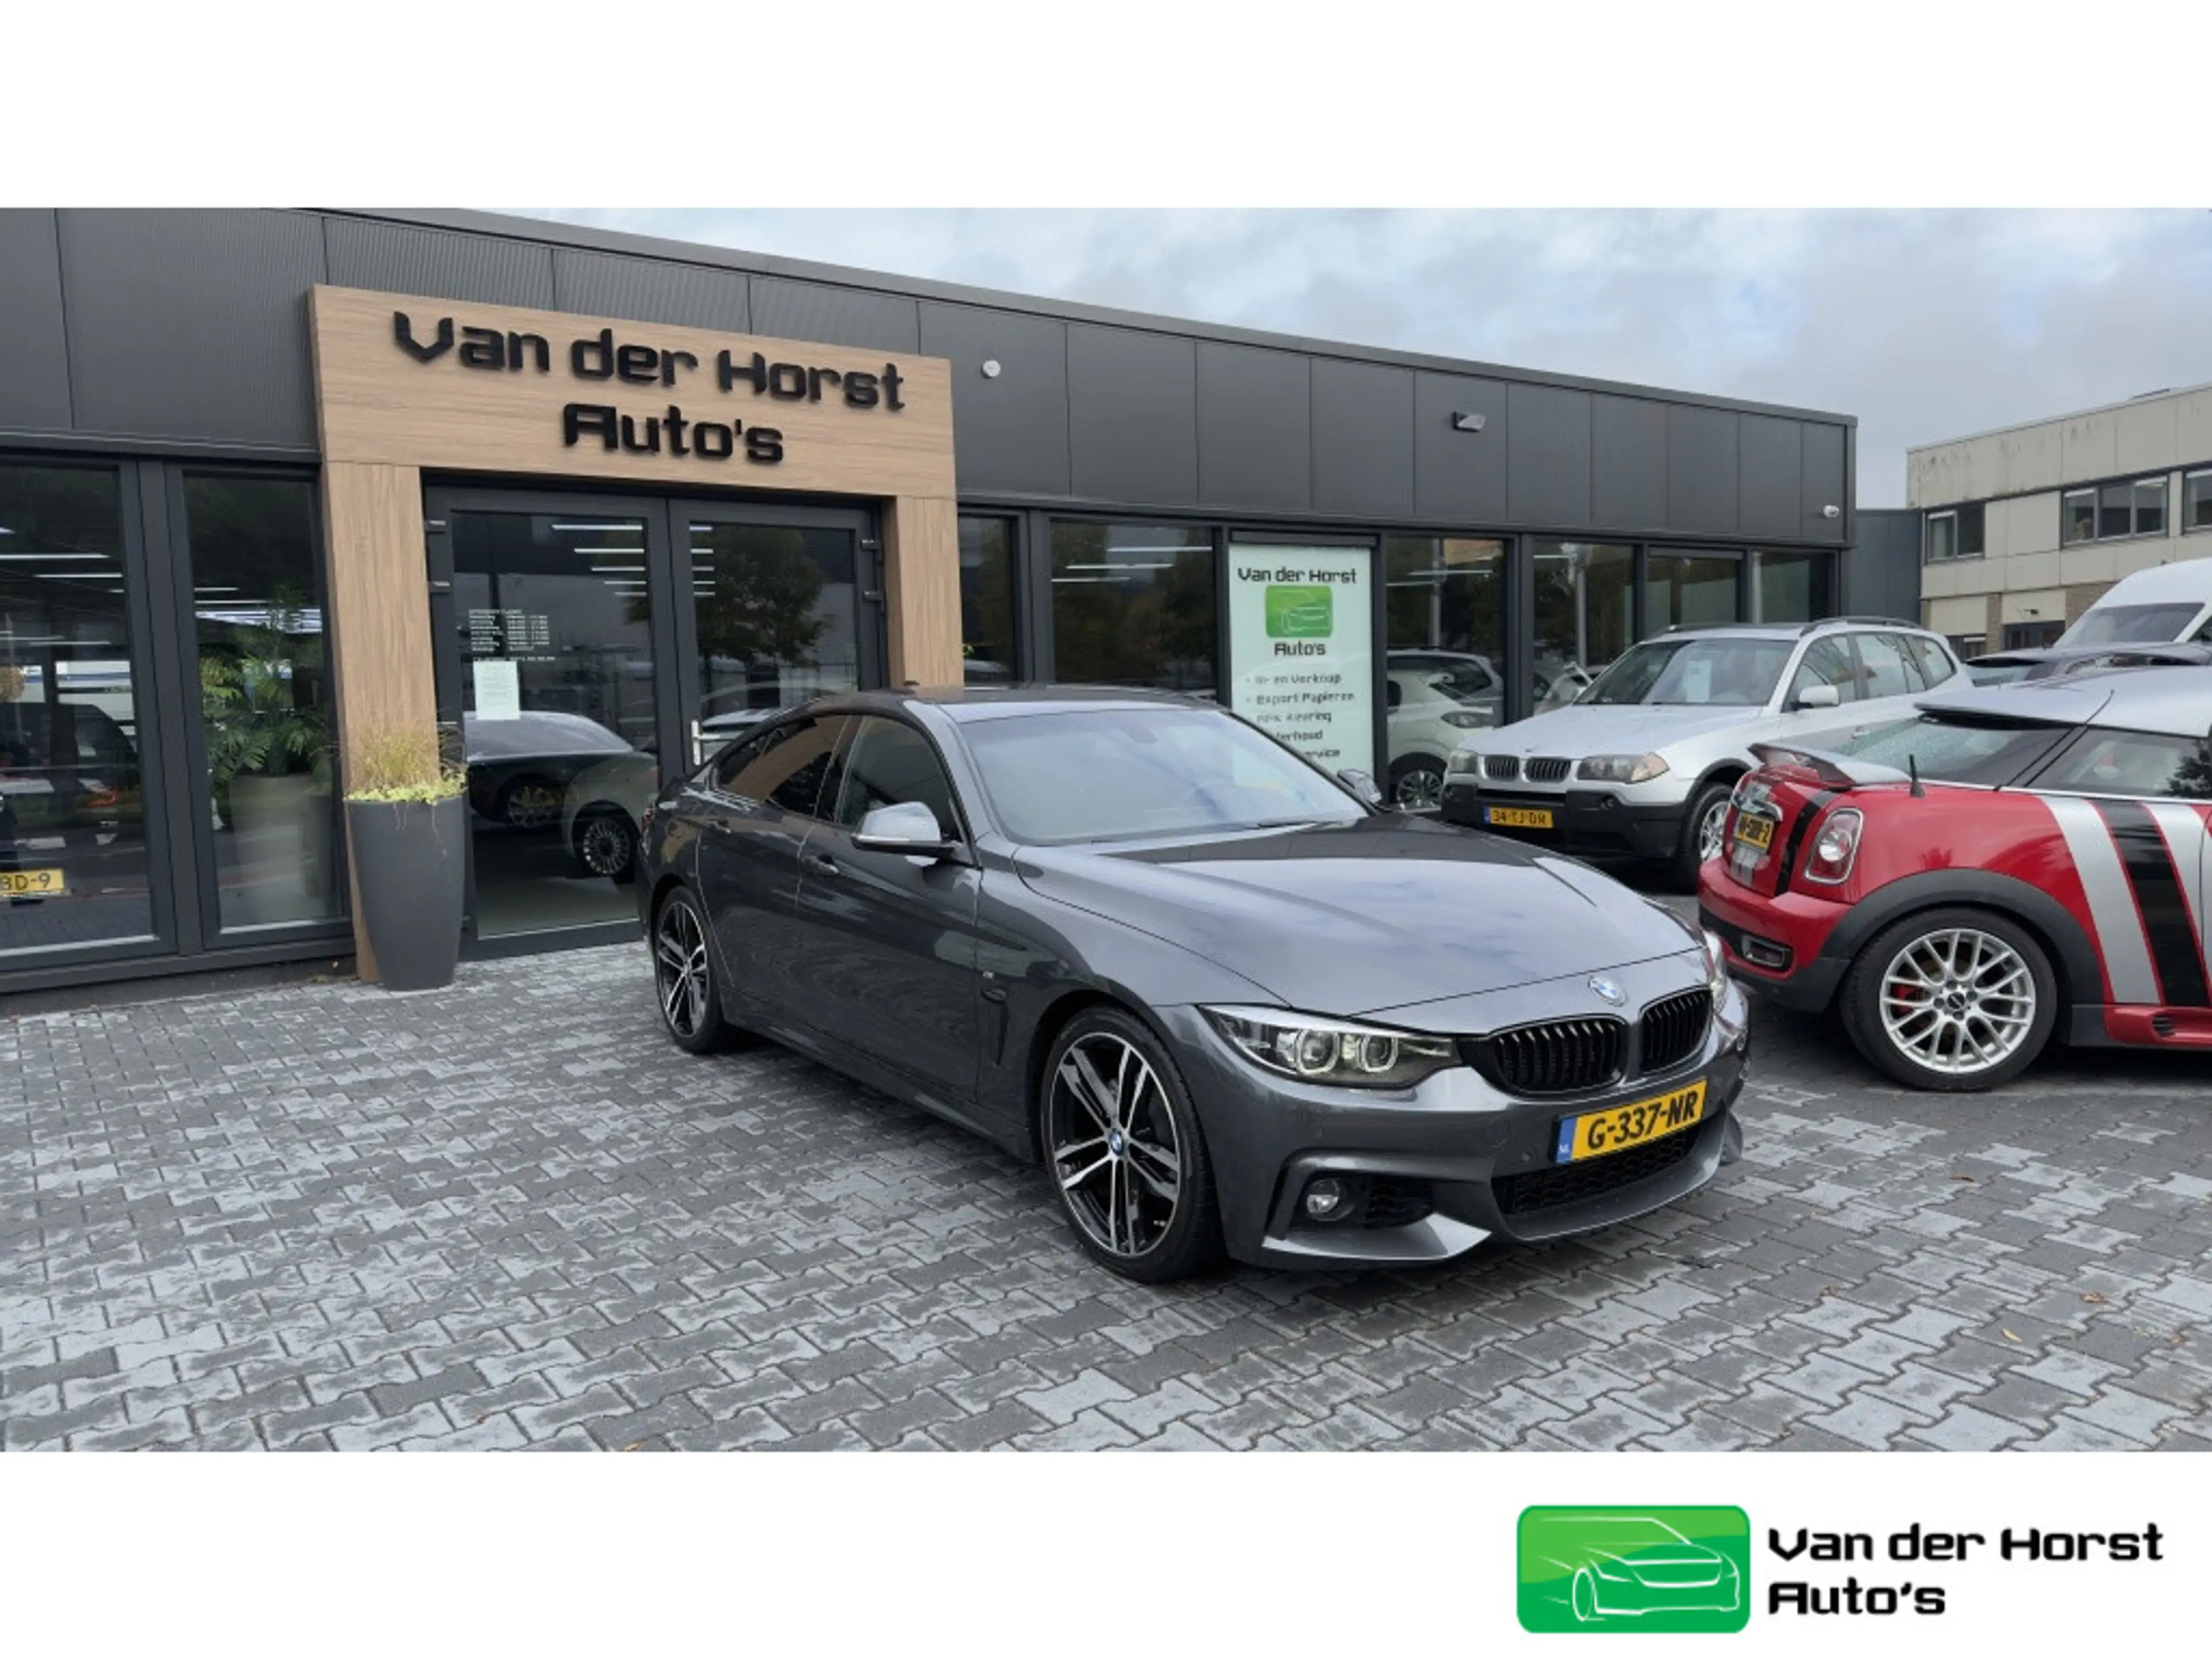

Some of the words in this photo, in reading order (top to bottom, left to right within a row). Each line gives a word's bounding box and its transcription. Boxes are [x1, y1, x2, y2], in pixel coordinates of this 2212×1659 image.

[393, 311, 550, 373] Van
[570, 328, 698, 387] der
[717, 349, 905, 411] Horst
[562, 403, 784, 464] Auto's
[1237, 567, 1271, 582] Van
[1275, 566, 1305, 582] der
[1309, 568, 1357, 584] Horst
[1274, 640, 1326, 656] Auto's
[1588, 1091, 1698, 1149] G-337-NR
